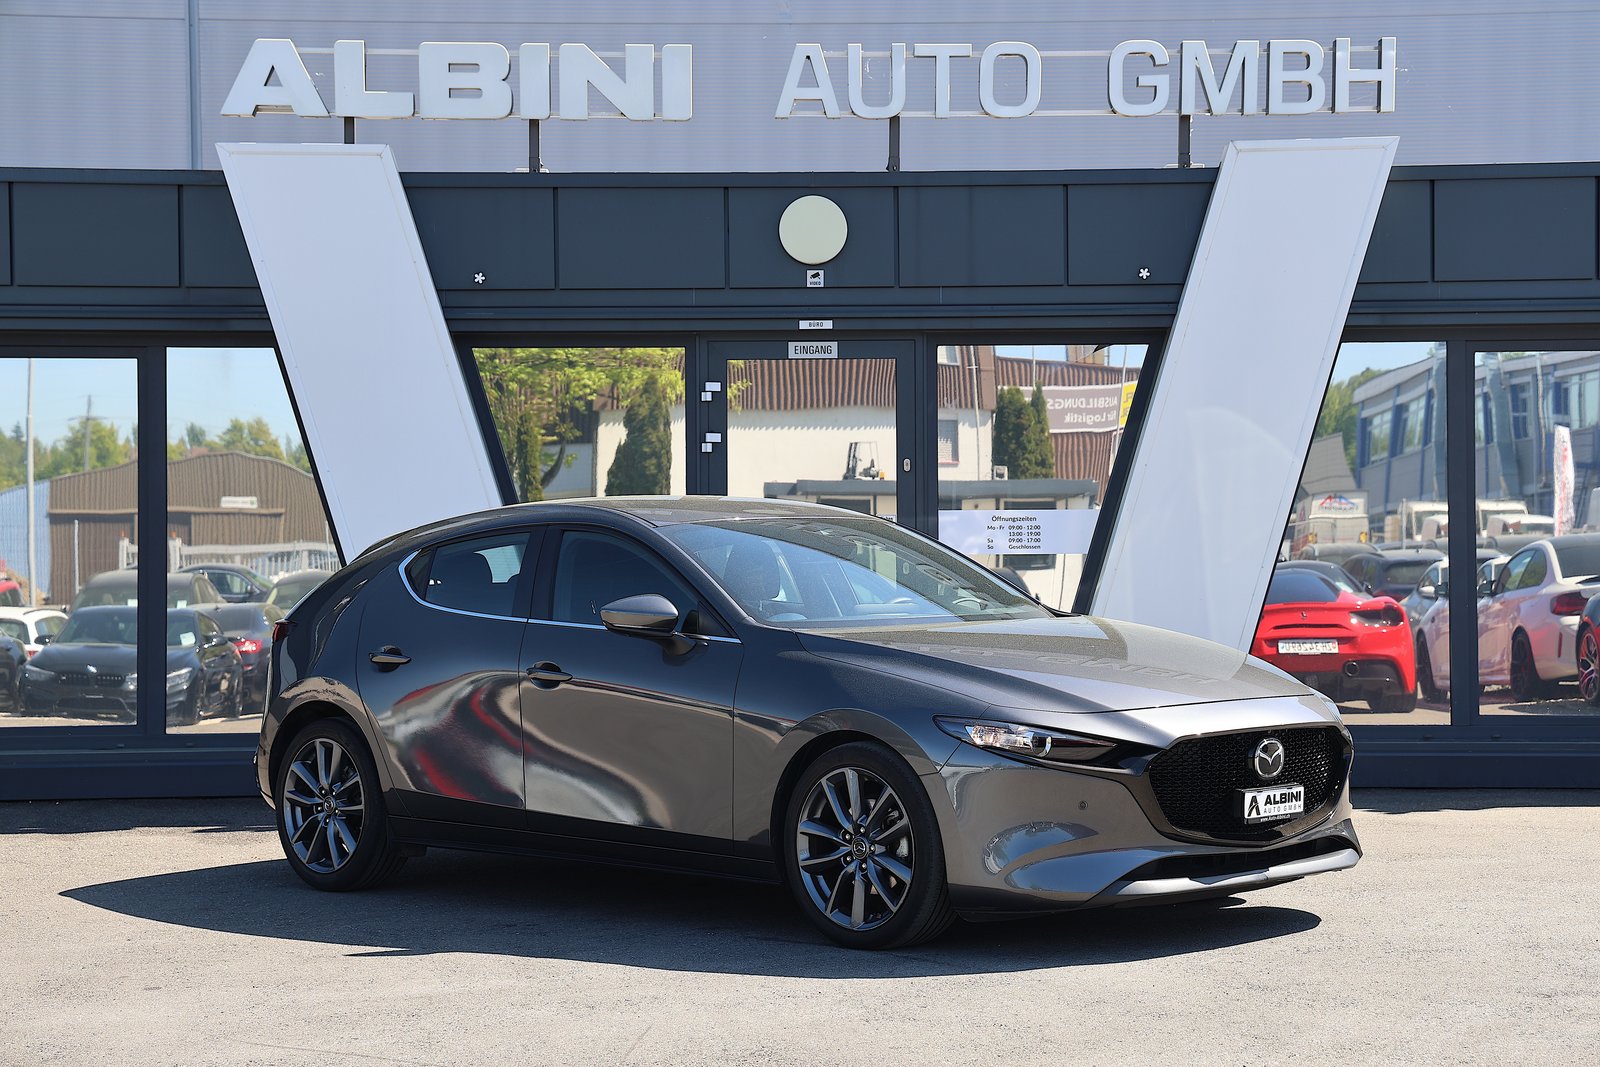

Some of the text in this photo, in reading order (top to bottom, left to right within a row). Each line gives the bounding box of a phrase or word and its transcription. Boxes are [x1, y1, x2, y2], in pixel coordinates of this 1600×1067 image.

[220, 37, 1397, 121] ALBINI AUTO GMBH
[794, 345, 833, 355] EINGANG
[991, 515, 1037, 523] Öffnungszeiten
[1264, 790, 1302, 806] ALBINI
[1264, 804, 1302, 814] AUTO GMBH
